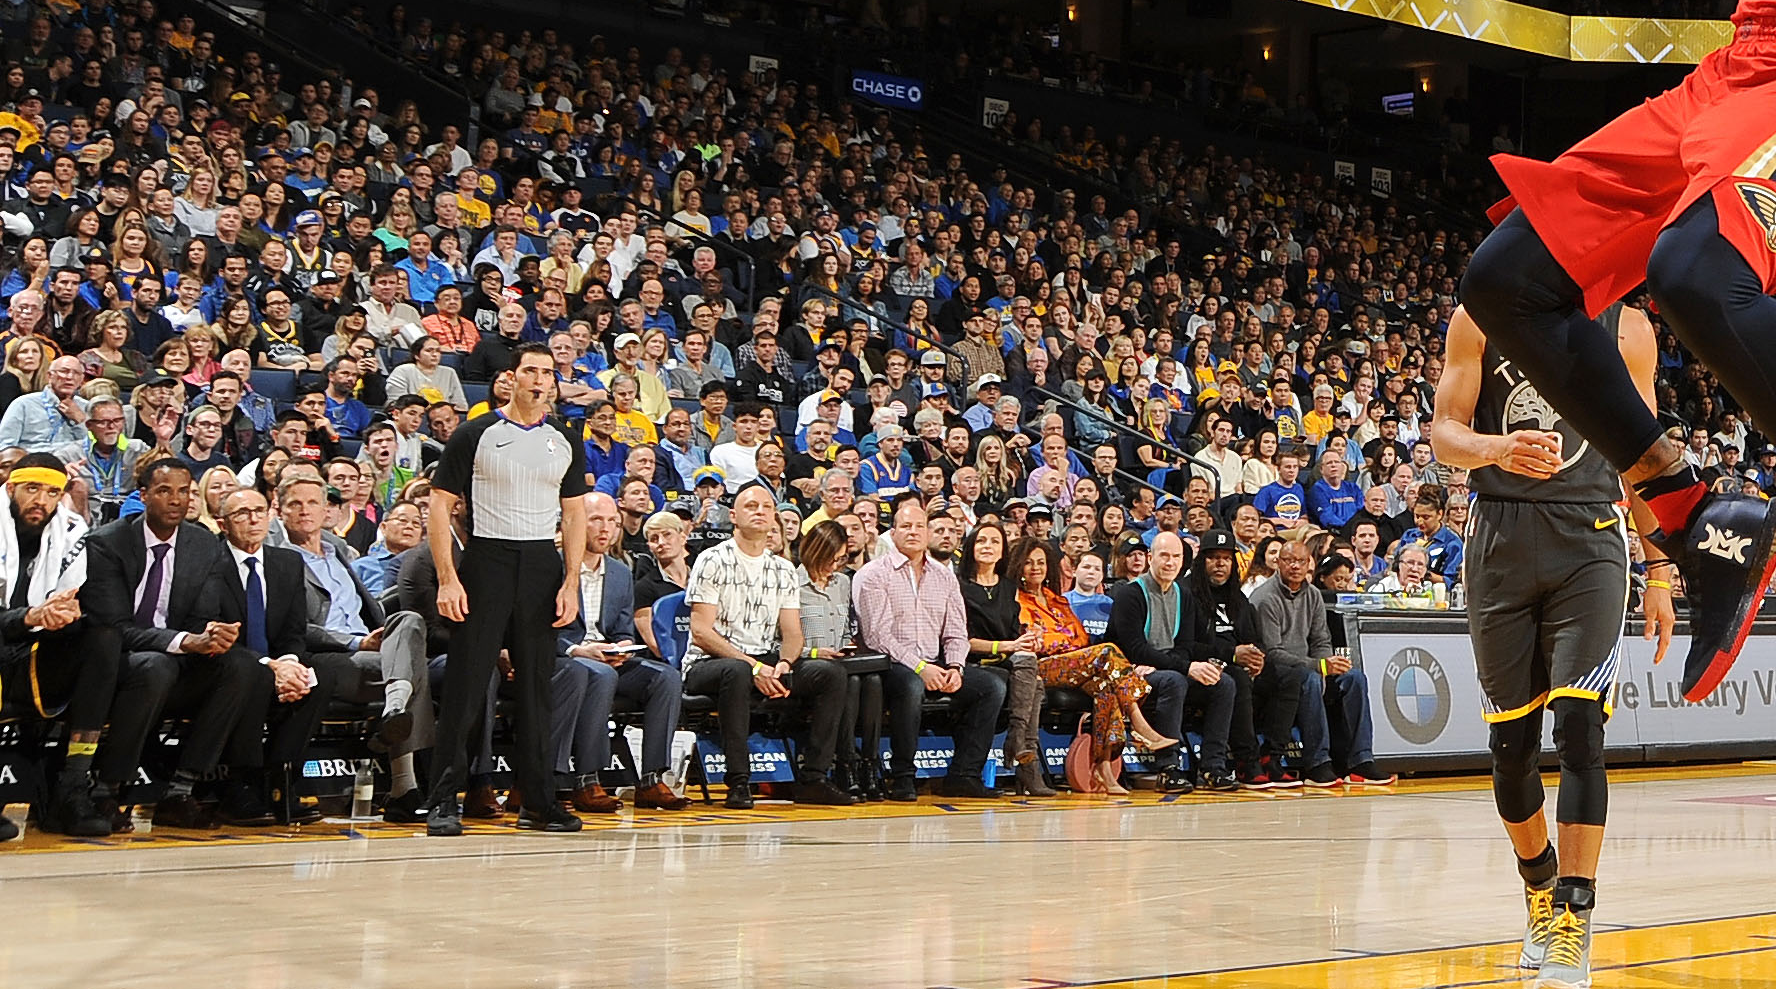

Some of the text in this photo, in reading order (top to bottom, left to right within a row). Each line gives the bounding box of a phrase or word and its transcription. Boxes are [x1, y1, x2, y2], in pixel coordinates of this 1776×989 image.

[852, 77, 905, 99] CHASE
[987, 102, 1005, 113] SEC
[1386, 649, 1442, 680] BMW
